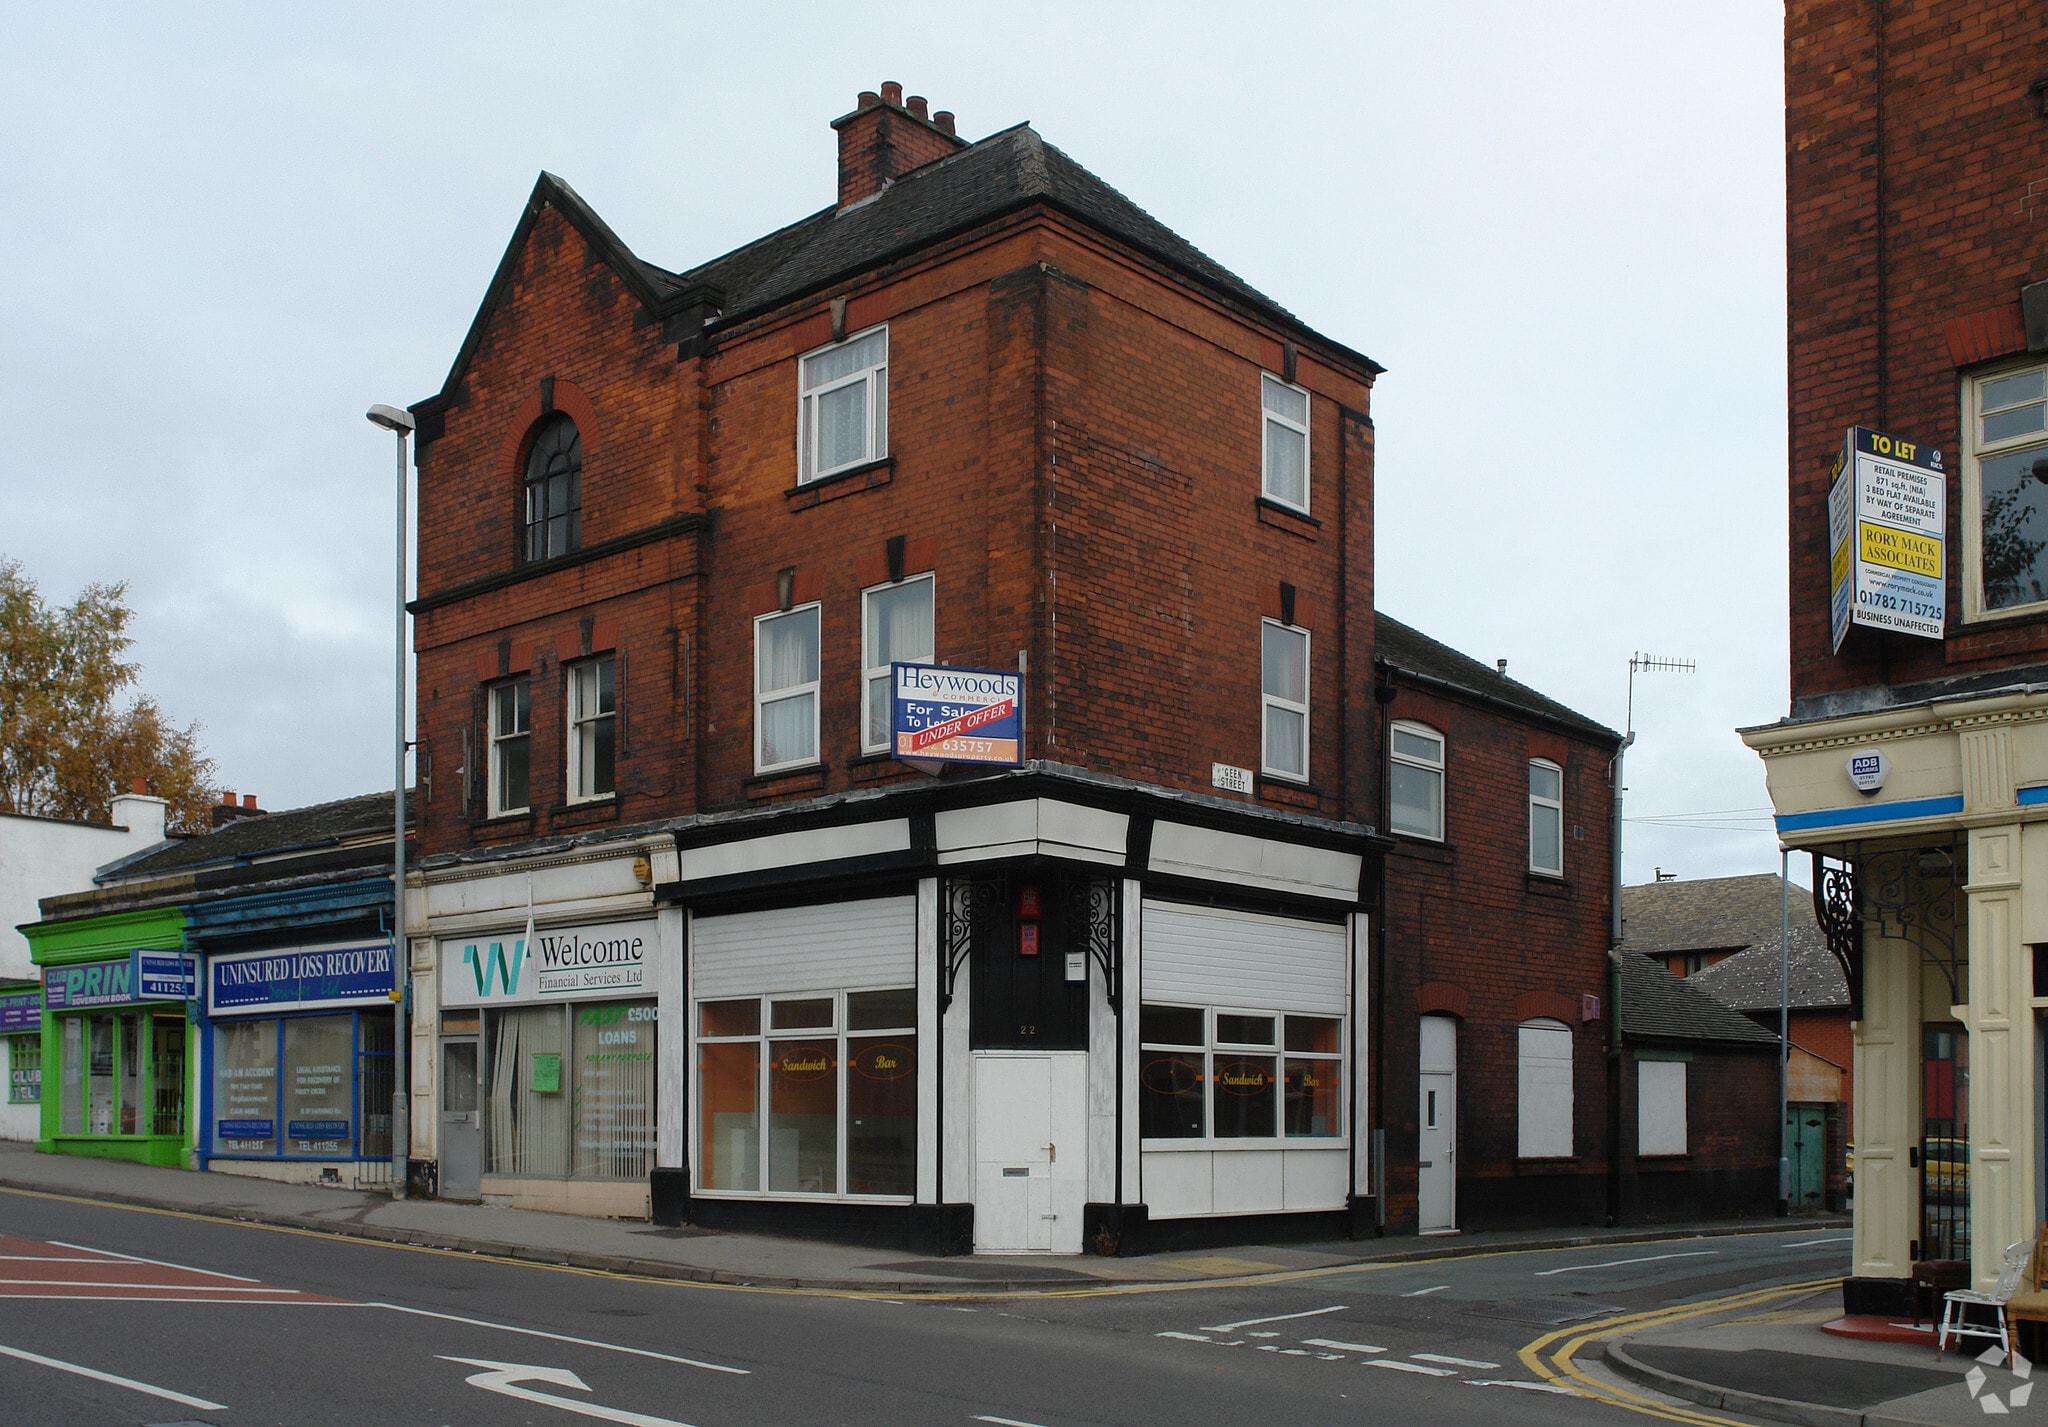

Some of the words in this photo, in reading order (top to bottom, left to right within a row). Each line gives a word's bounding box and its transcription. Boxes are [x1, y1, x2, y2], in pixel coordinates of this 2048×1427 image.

[1871, 433, 1891, 454] TO
[1895, 440, 1917, 461] LET
[1874, 465, 1896, 478] RETAIL
[1897, 471, 1928, 485] PREMISES
[1875, 476, 1889, 486] 871
[1909, 485, 1926, 497] (NIA)
[1865, 485, 1870, 493] 3
[1871, 486, 1885, 496] BED
[1886, 490, 1902, 500] FLAT
[1903, 494, 1936, 509] AVAILABLE
[1866, 496, 1875, 505] BY
[1876, 498, 1893, 509] WAY
[1894, 502, 1904, 512] OF
[1905, 504, 1936, 519] SEPARATE
[1881, 510, 1922, 526] AGREEMENT
[1866, 529, 1900, 548] RORY
[1901, 537, 1936, 557] MACK
[1866, 546, 1936, 572] ASSOCIATES
[1860, 590, 1897, 610] 01782
[1900, 599, 1942, 620] 715725
[1857, 609, 1892, 625] BUSINESS
[1894, 617, 1940, 634] UNAFFECTED
[900, 666, 1016, 696] Heywoods
[942, 693, 1009, 703] COMMERCI
[907, 703, 933, 715] For
[906, 715, 921, 727] To
[919, 721, 962, 745] UNDER
[967, 704, 1006, 728] OFFER
[942, 739, 993, 753] 635757
[1854, 757, 1878, 769] ADB
[1854, 766, 1879, 774] ALARMS
[1221, 777, 1246, 791] STREET
[539, 934, 644, 967] Welcome
[221, 958, 289, 986] UNINSURED
[292, 954, 324, 979] LOSS
[326, 948, 392, 976] RECOVERY
[47, 971, 67, 984] CLUB
[538, 974, 579, 990] Financial
[583, 972, 621, 986] Services
[626, 969, 643, 983] Ltd
[71, 995, 110, 1006] SOVEREIGN
[111, 992, 132, 1002] BOOK
[579, 1006, 627, 1026] FAST
[598, 1030, 637, 1045] LOANS
[584, 1054, 600, 1062] FOR
[600, 1053, 617, 1061] ANY
[617, 1052, 653, 1061] PURPOSE
[781, 1057, 827, 1072] Sandwich
[875, 1055, 898, 1070] Bar
[13, 1069, 41, 1084] CLUB
[233, 1068, 244, 1078] AN
[244, 1067, 274, 1077] ACCIDENT
[1222, 1072, 1264, 1087] Sandwich
[1303, 1074, 1320, 1087] Bar
[228, 1140, 239, 1150] TEL
[298, 1141, 312, 1151] TEL
[313, 1141, 338, 1152] 411255
